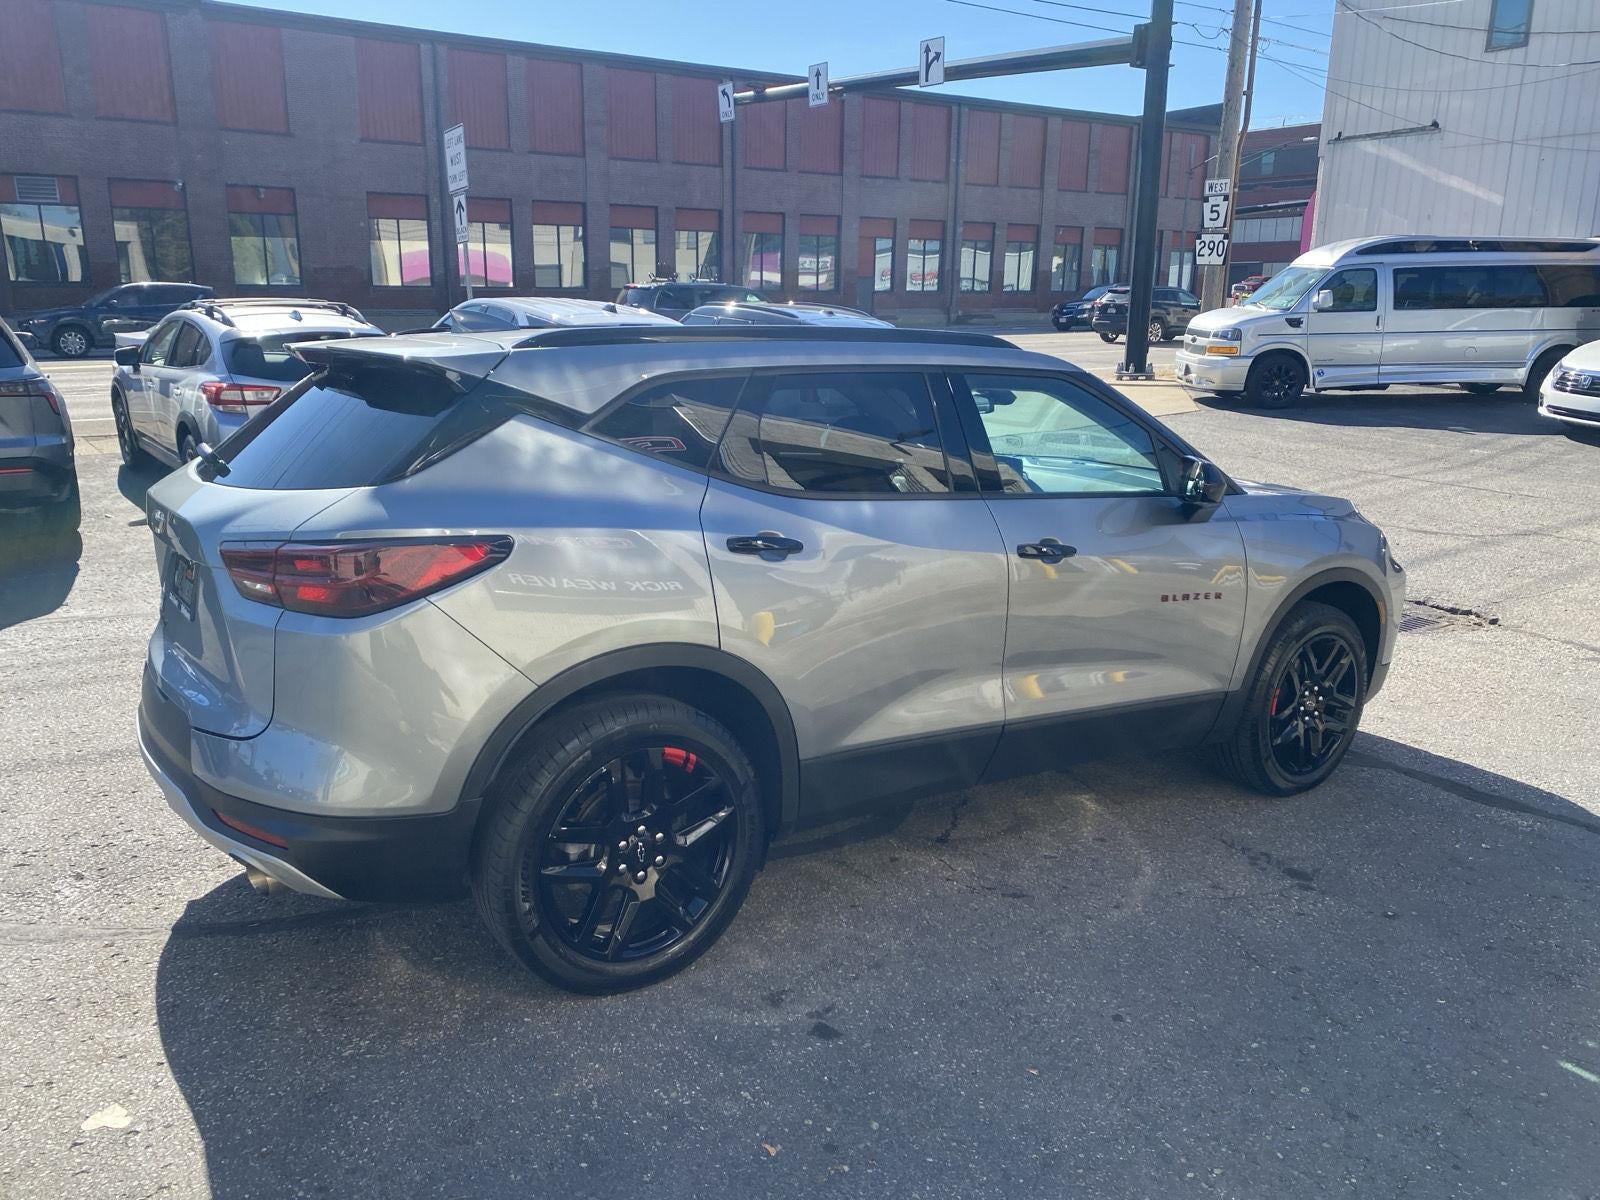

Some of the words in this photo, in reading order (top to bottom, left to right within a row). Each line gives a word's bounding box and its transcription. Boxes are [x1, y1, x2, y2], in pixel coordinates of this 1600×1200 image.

[811, 92, 825, 101] ONLY
[722, 110, 733, 118] ONLY
[1208, 182, 1228, 192] WEST
[1209, 204, 1220, 221] 5
[1197, 240, 1225, 257] 290
[1161, 592, 1222, 602] BLAZER
